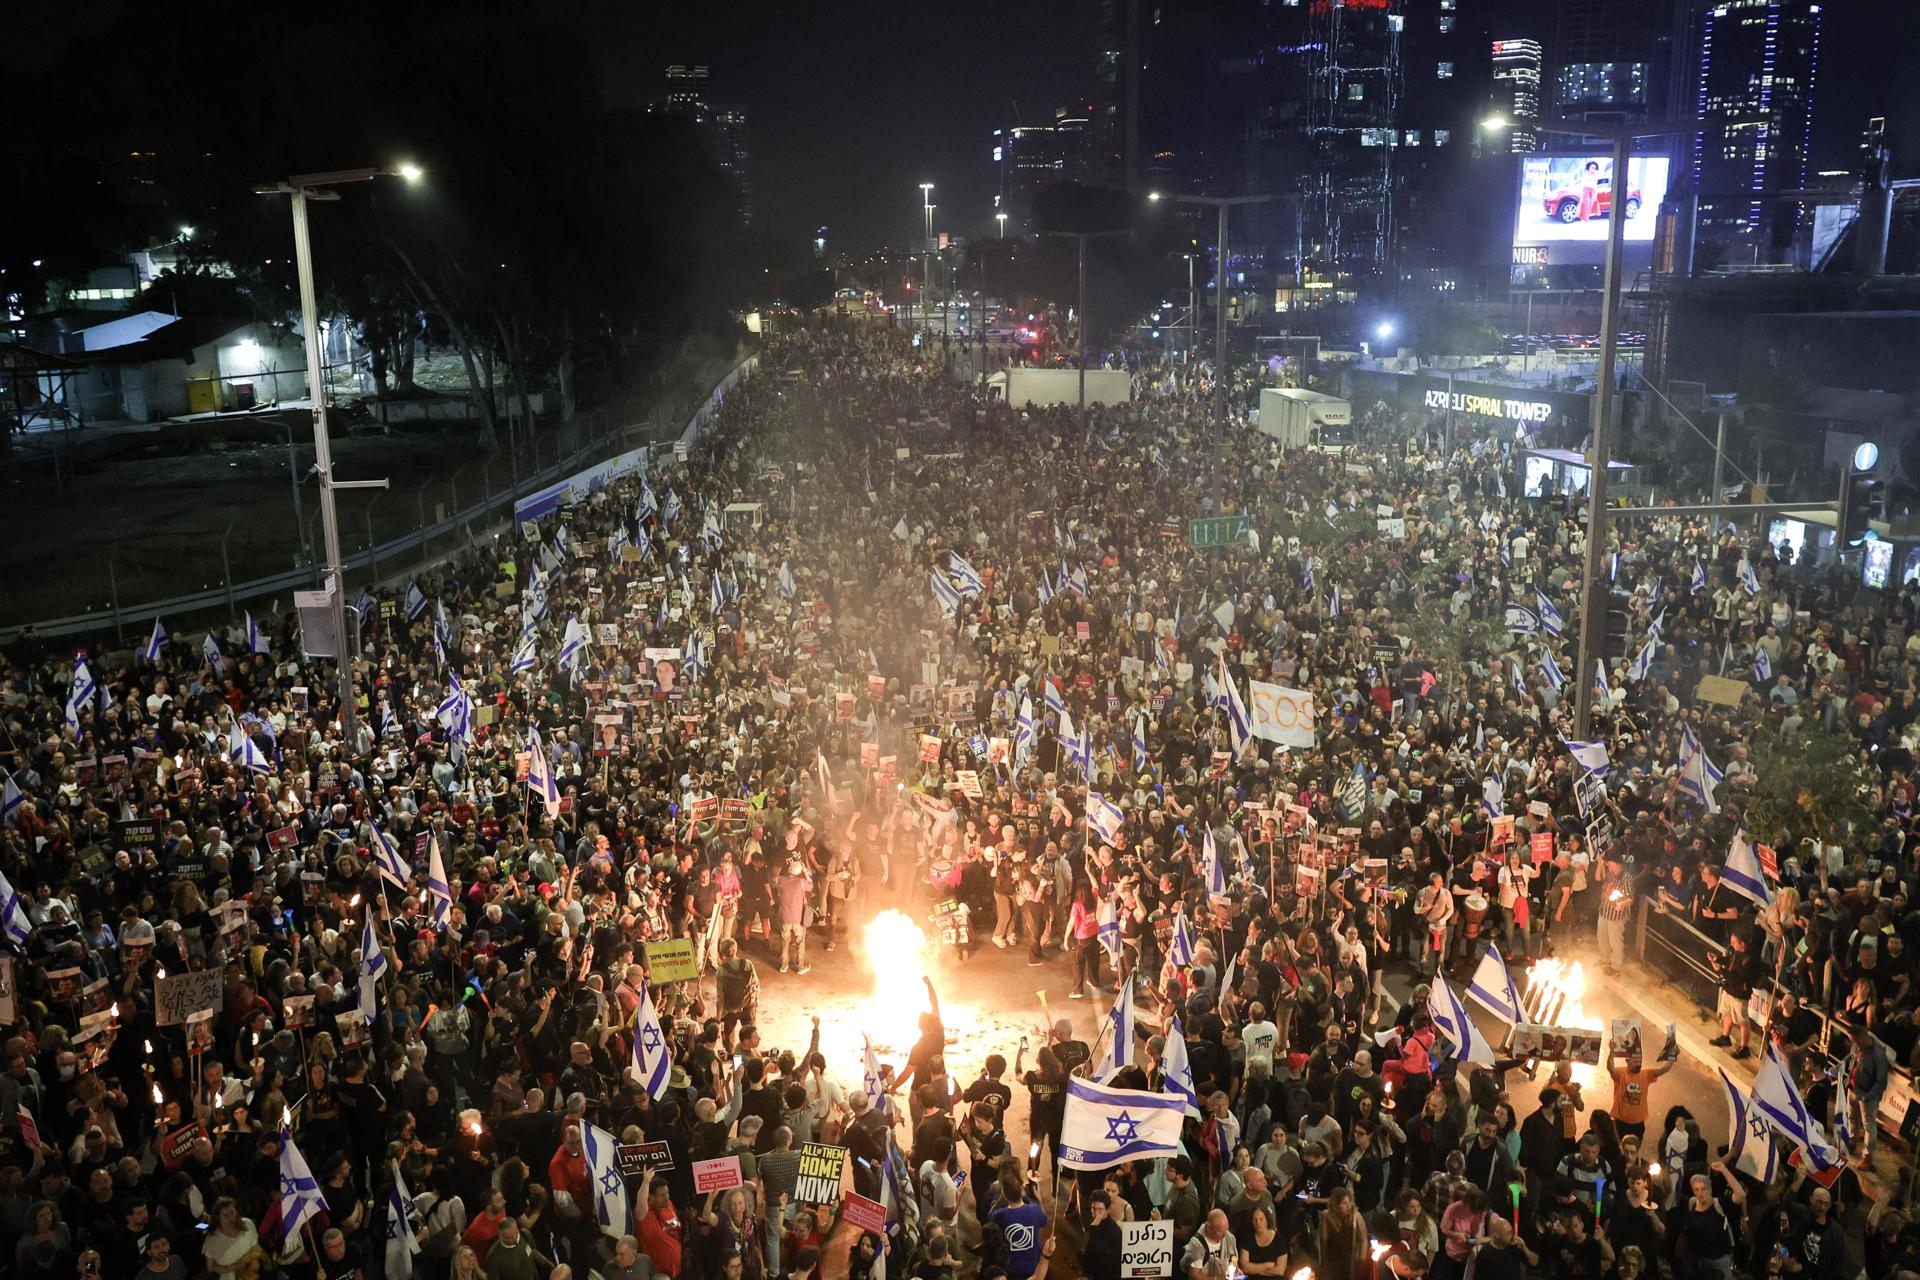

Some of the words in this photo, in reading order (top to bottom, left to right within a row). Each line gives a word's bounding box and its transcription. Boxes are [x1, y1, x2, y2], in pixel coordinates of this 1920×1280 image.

[1466, 395, 1503, 418] SPIRAL
[1253, 691, 1314, 733] SOS
[624, 1152, 648, 1163] יחזרו
[651, 1151, 667, 1160] הם
[802, 1144, 818, 1156] ALL
[822, 1147, 845, 1160] THEM
[798, 1155, 843, 1180] HOME
[794, 1175, 839, 1204] NOW!
[1127, 1224, 1167, 1246] כולנו
[1121, 1248, 1172, 1265] חטופים
